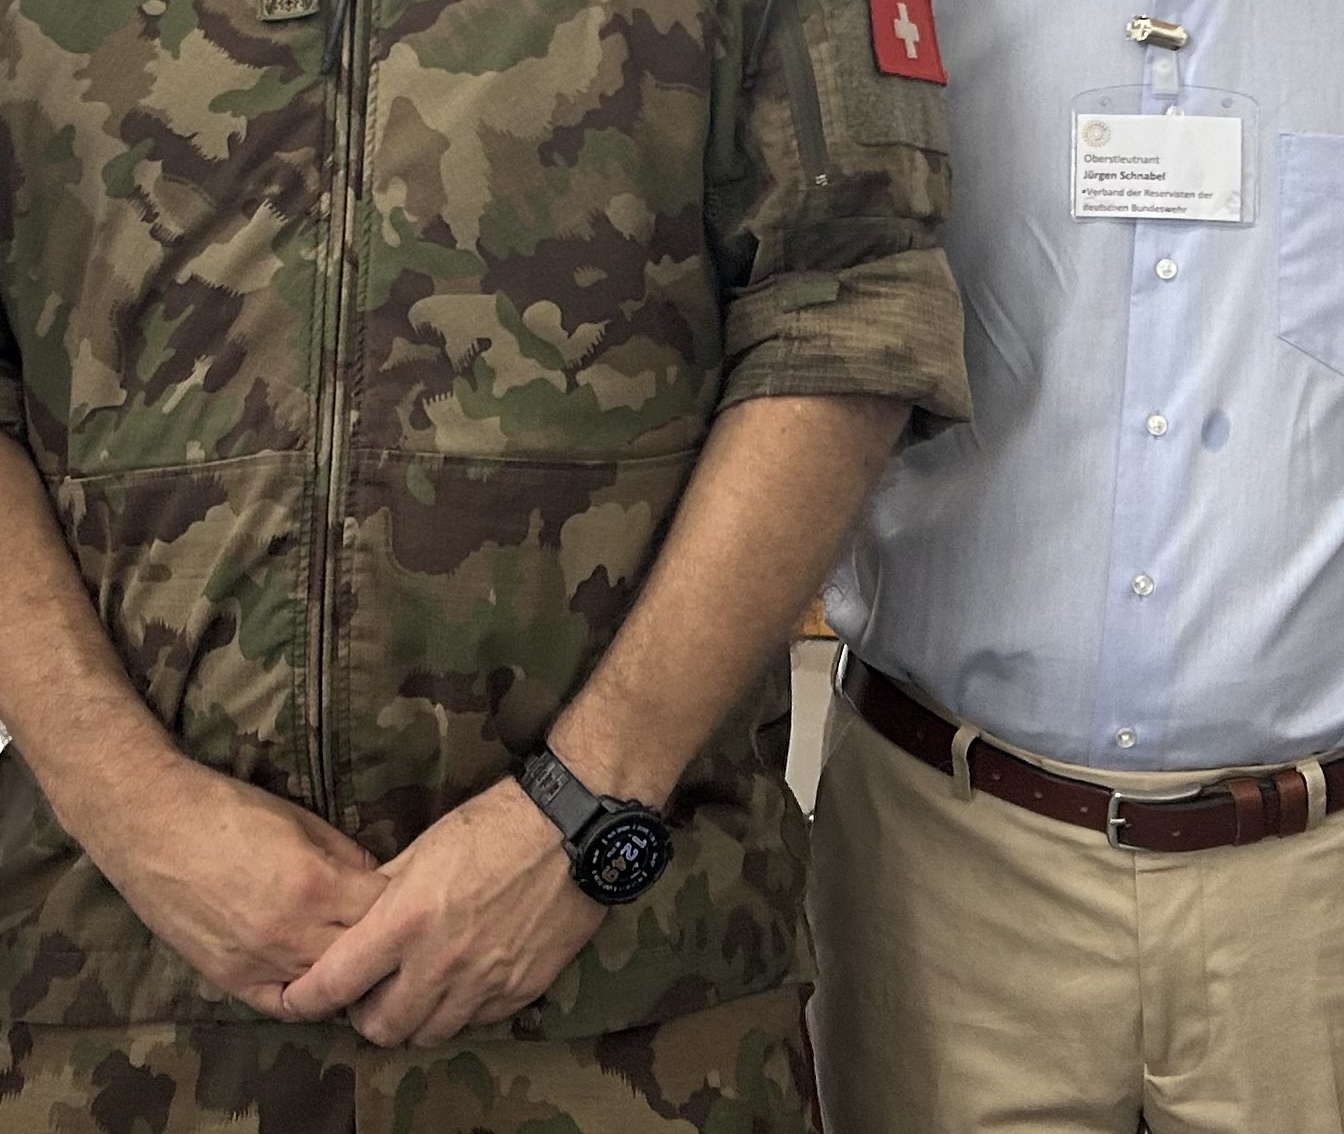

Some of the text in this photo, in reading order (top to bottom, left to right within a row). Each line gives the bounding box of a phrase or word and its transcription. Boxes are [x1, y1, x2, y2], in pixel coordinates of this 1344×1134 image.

[1083, 153, 1161, 165] Oberstleutnant
[1083, 170, 1166, 181] Jürgen Schnabel
[1126, 189, 1142, 198] der
[1144, 189, 1196, 199] Reservisten
[1198, 191, 1214, 200] der
[1131, 203, 1188, 214] Bundeswehr
